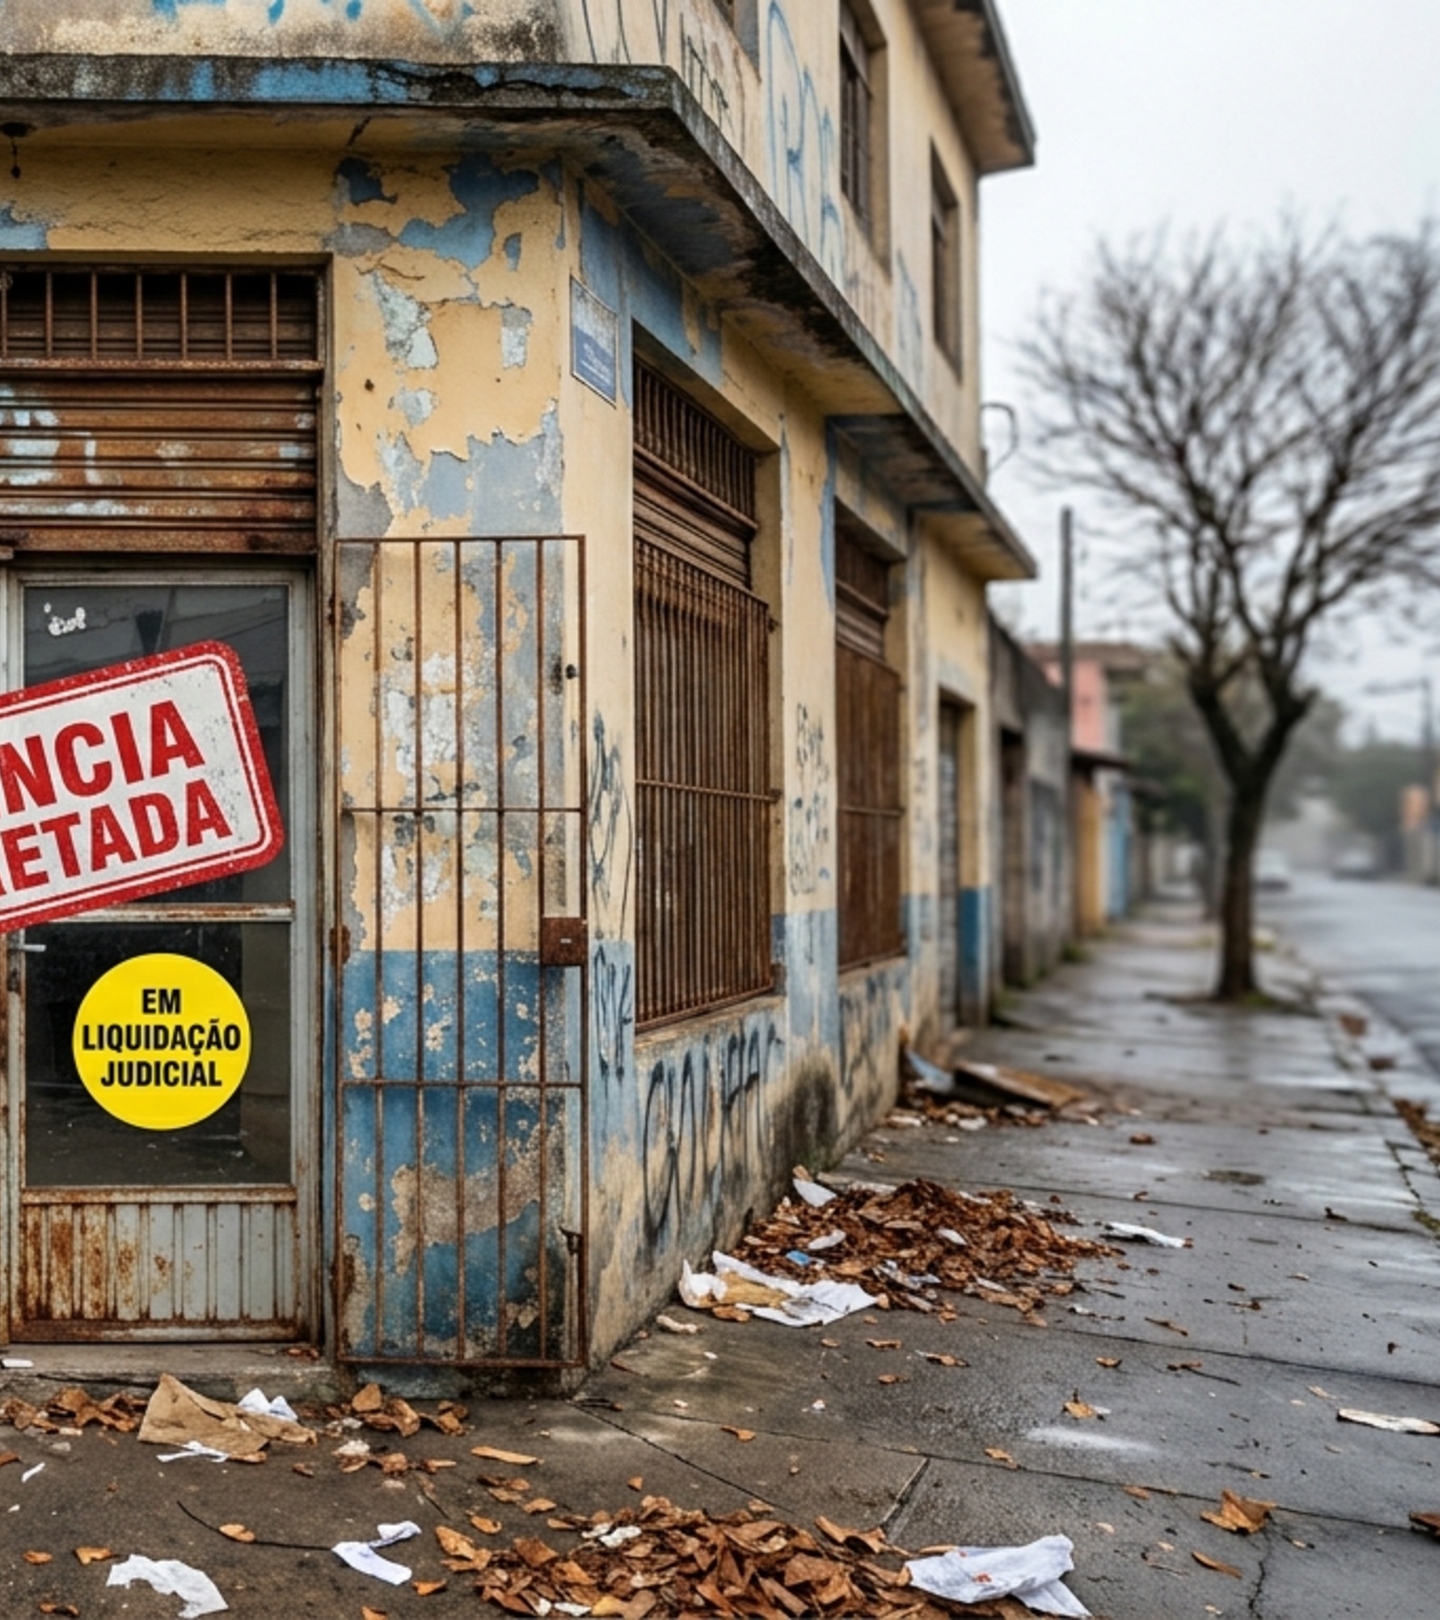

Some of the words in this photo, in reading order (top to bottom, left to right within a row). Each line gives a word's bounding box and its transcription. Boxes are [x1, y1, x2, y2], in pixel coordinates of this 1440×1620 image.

[142, 988, 181, 1014] EM
[83, 1018, 241, 1056] LIQUIDAÇÃO
[101, 1061, 222, 1087] JUDICIAL
